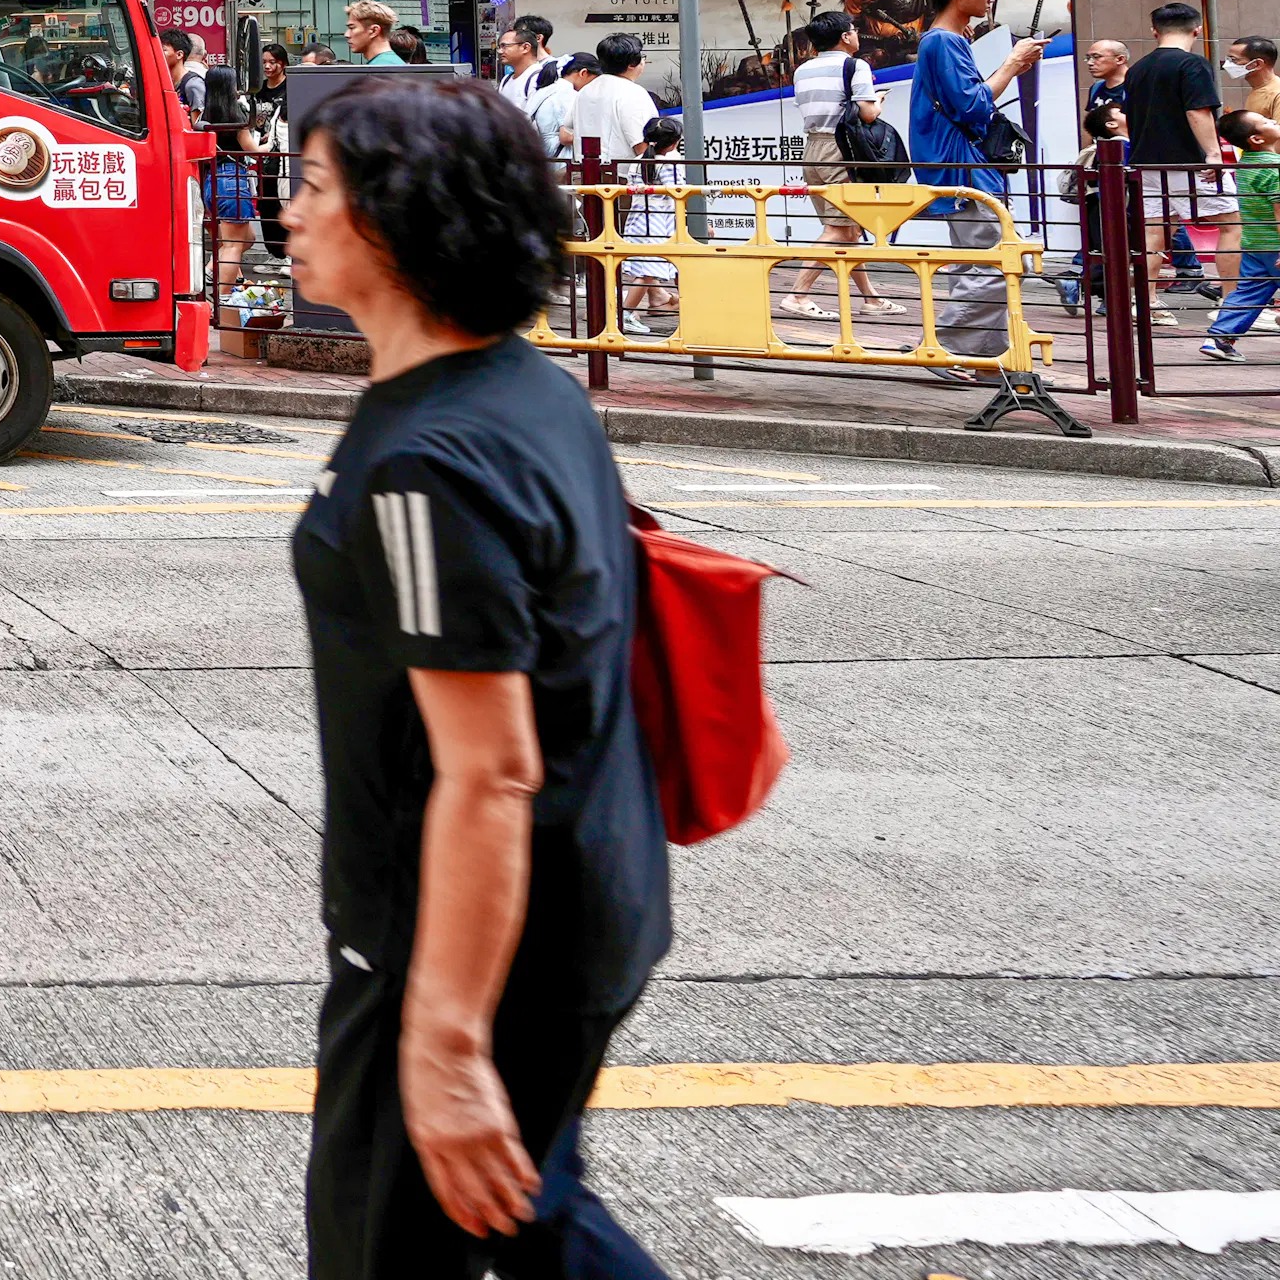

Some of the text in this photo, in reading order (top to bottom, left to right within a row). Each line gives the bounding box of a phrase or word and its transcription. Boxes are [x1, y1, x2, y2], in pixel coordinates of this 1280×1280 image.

[51, 150, 126, 175] 玩遊戲
[52, 177, 127, 201] 贏包包
